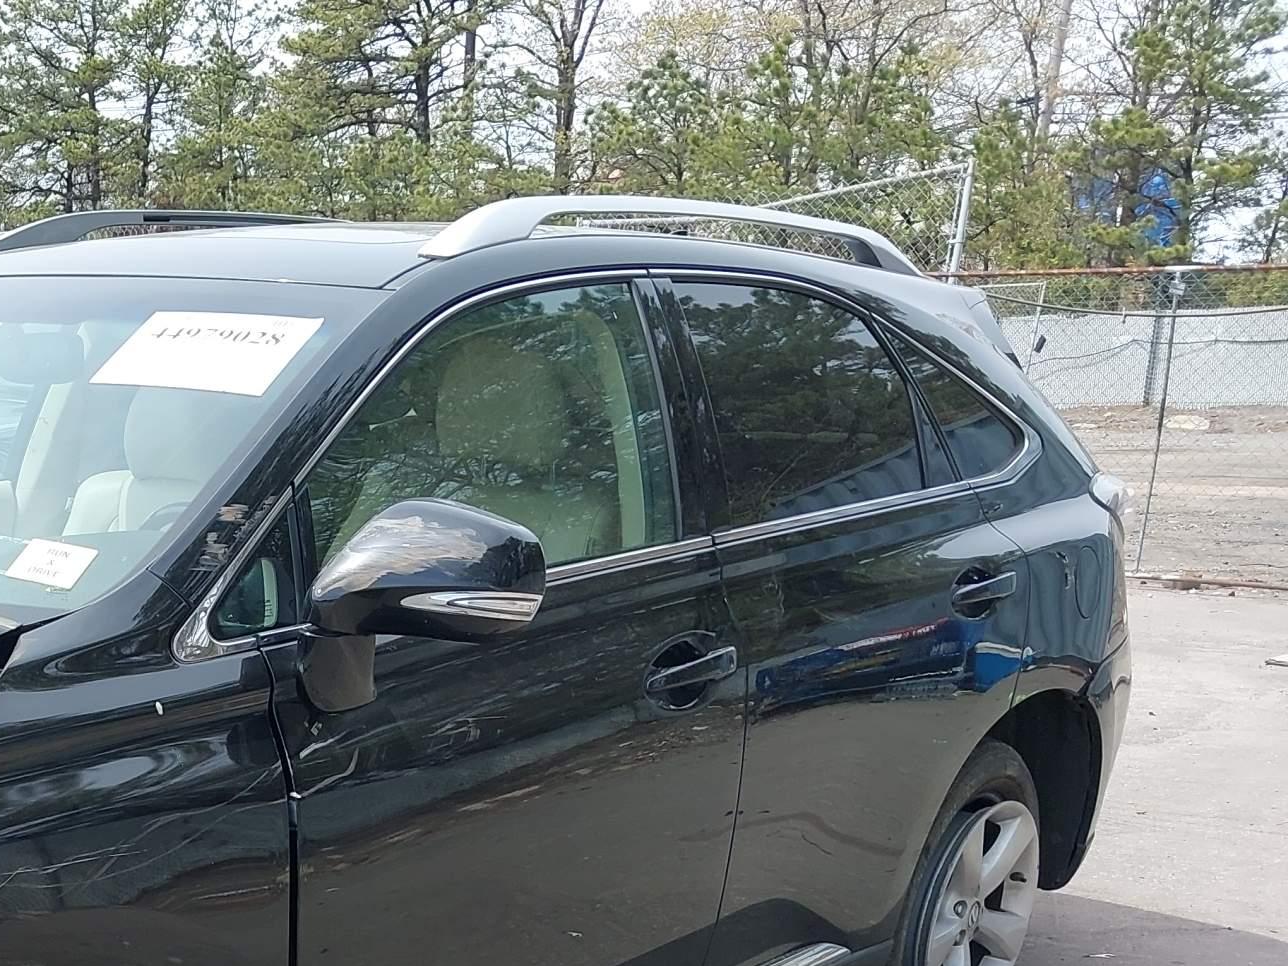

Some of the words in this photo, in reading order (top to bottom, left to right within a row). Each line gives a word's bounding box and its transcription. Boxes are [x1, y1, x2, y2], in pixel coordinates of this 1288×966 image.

[152, 327, 286, 345] 44979028
[46, 548, 73, 559] RUN
[27, 566, 60, 578] DRIVE
